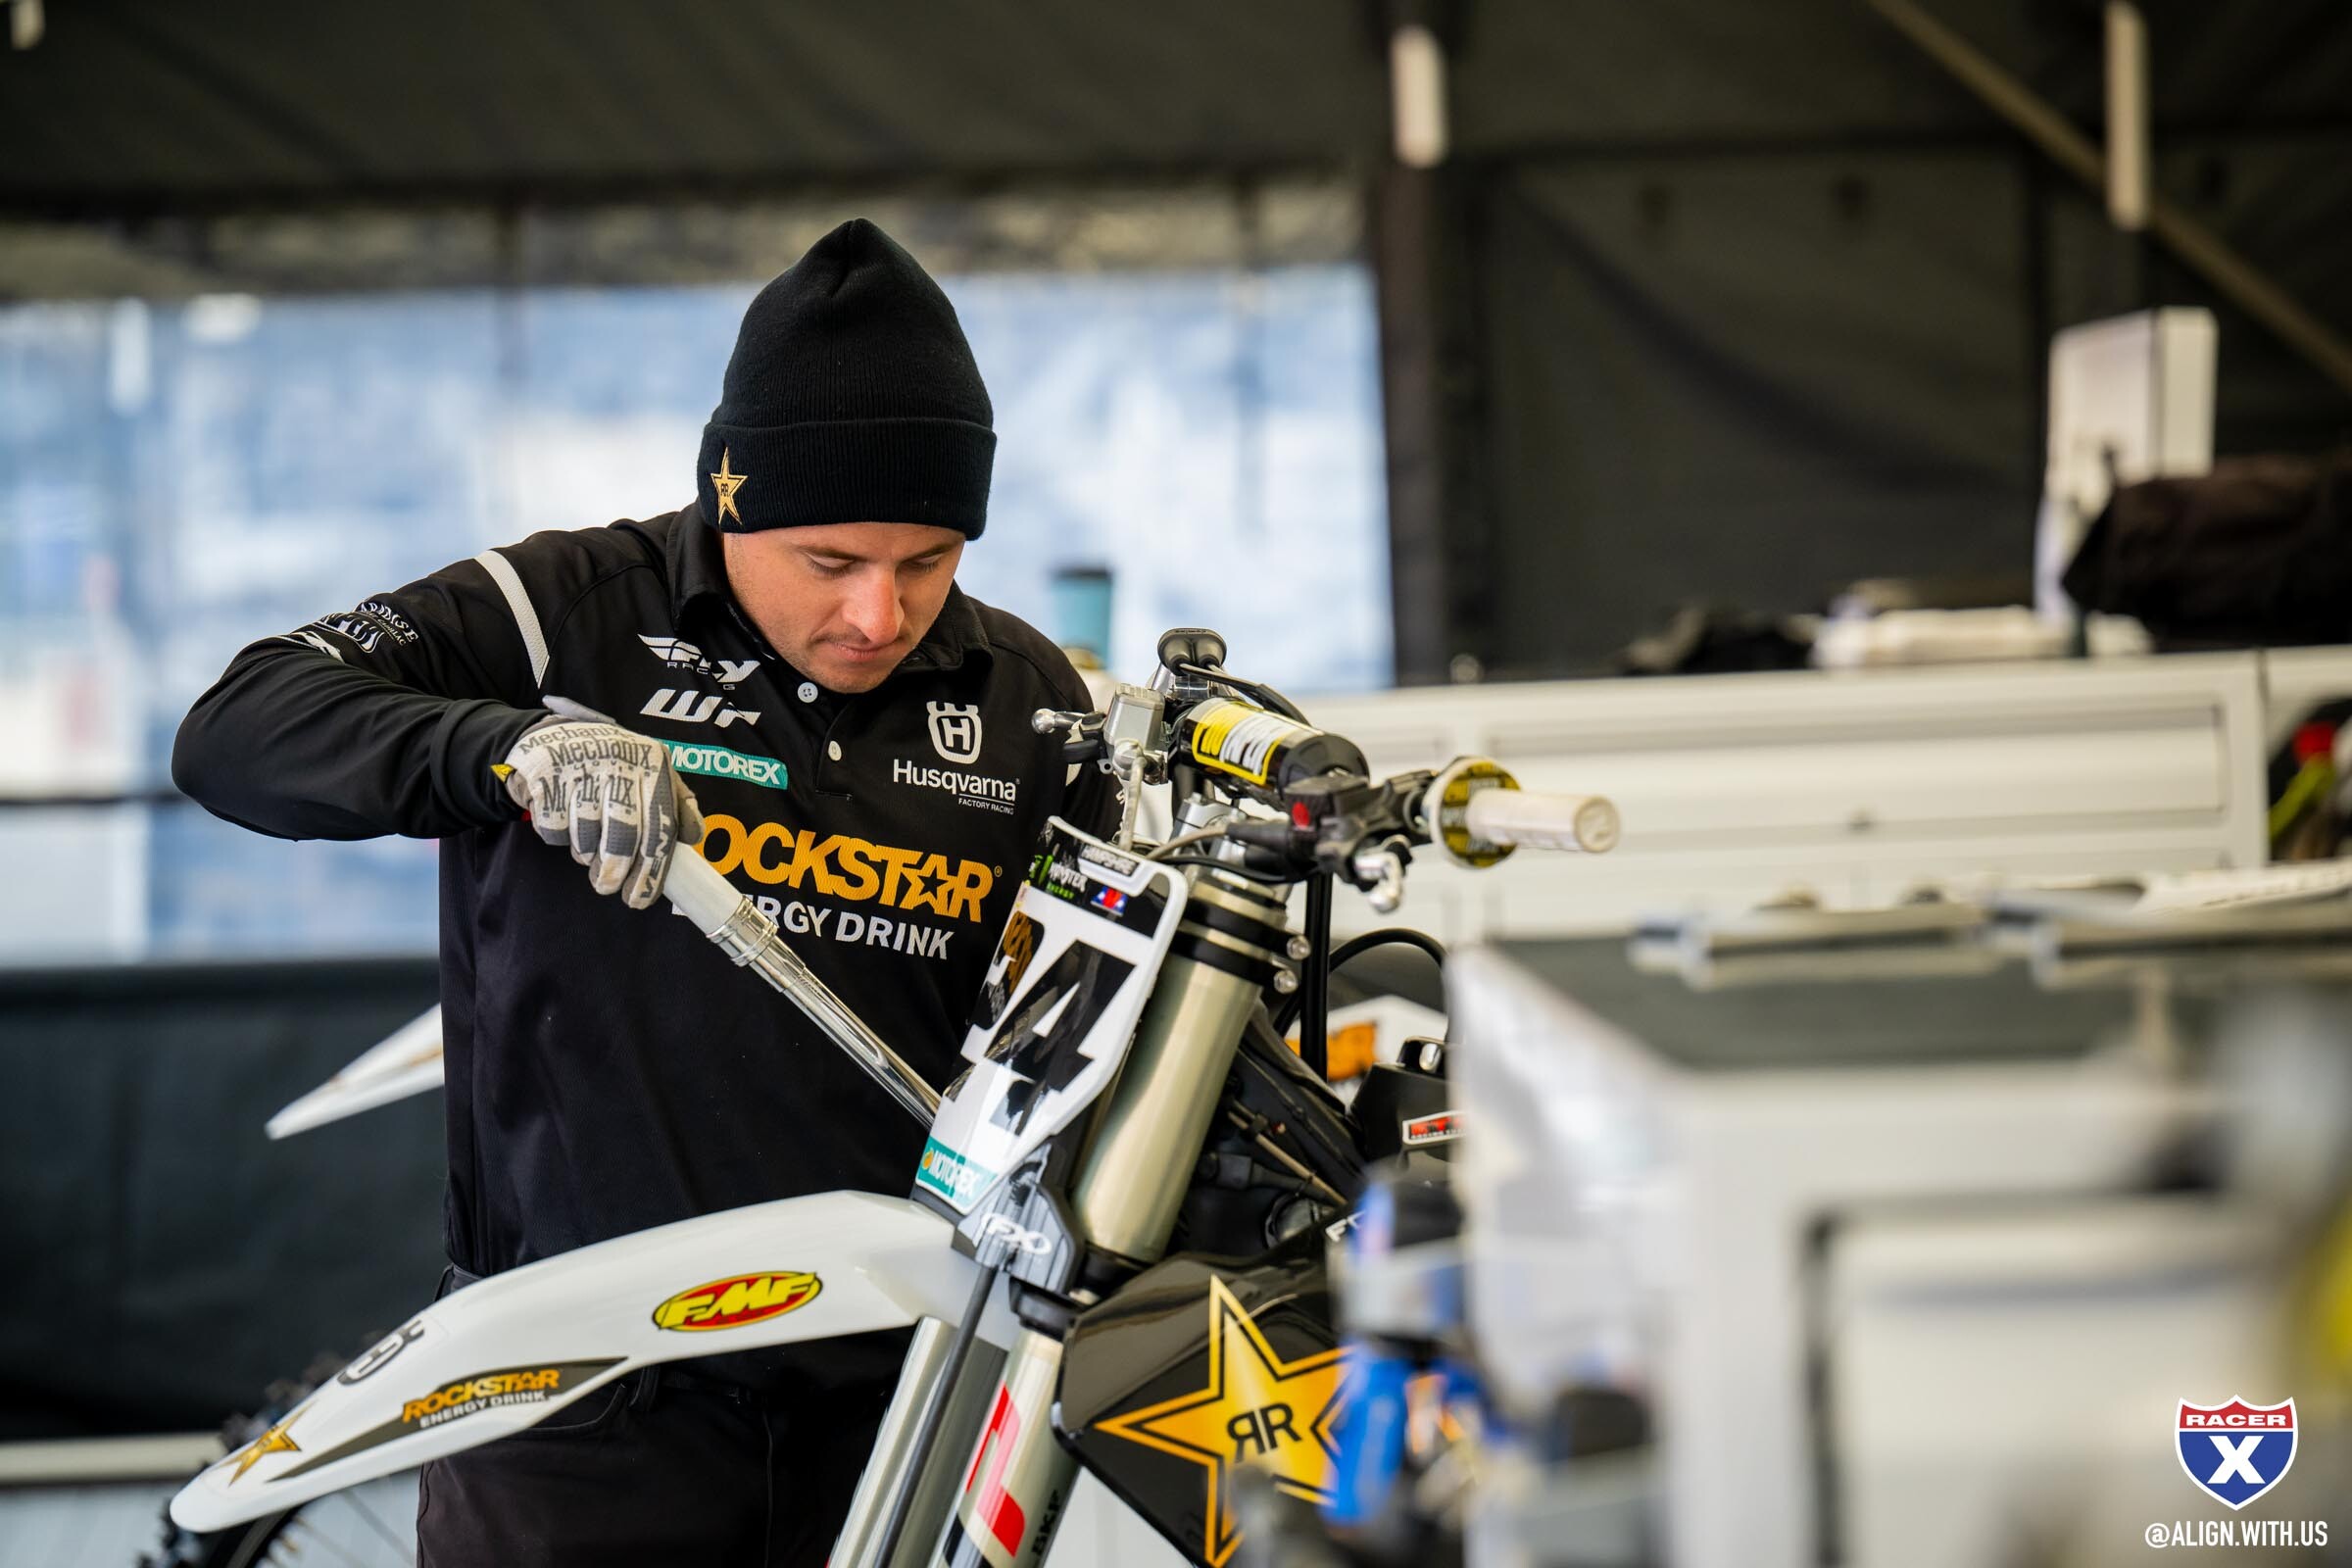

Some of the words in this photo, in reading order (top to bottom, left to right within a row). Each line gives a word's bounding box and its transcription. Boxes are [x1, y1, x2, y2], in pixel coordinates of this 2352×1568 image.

[546, 735, 654, 770] Mechanix
[669, 745, 781, 785] MOTOREX
[893, 759, 1016, 802] Husqvarna
[958, 798, 991, 810] FACTORY
[991, 804, 1014, 815] RACING
[691, 813, 994, 923] OCKSTAR
[834, 910, 955, 960] DRINK
[659, 1272, 817, 1330] FMF
[403, 1369, 561, 1423] ROCKSTAR
[419, 1397, 488, 1429] ENERGY
[490, 1390, 547, 1406] DRINK
